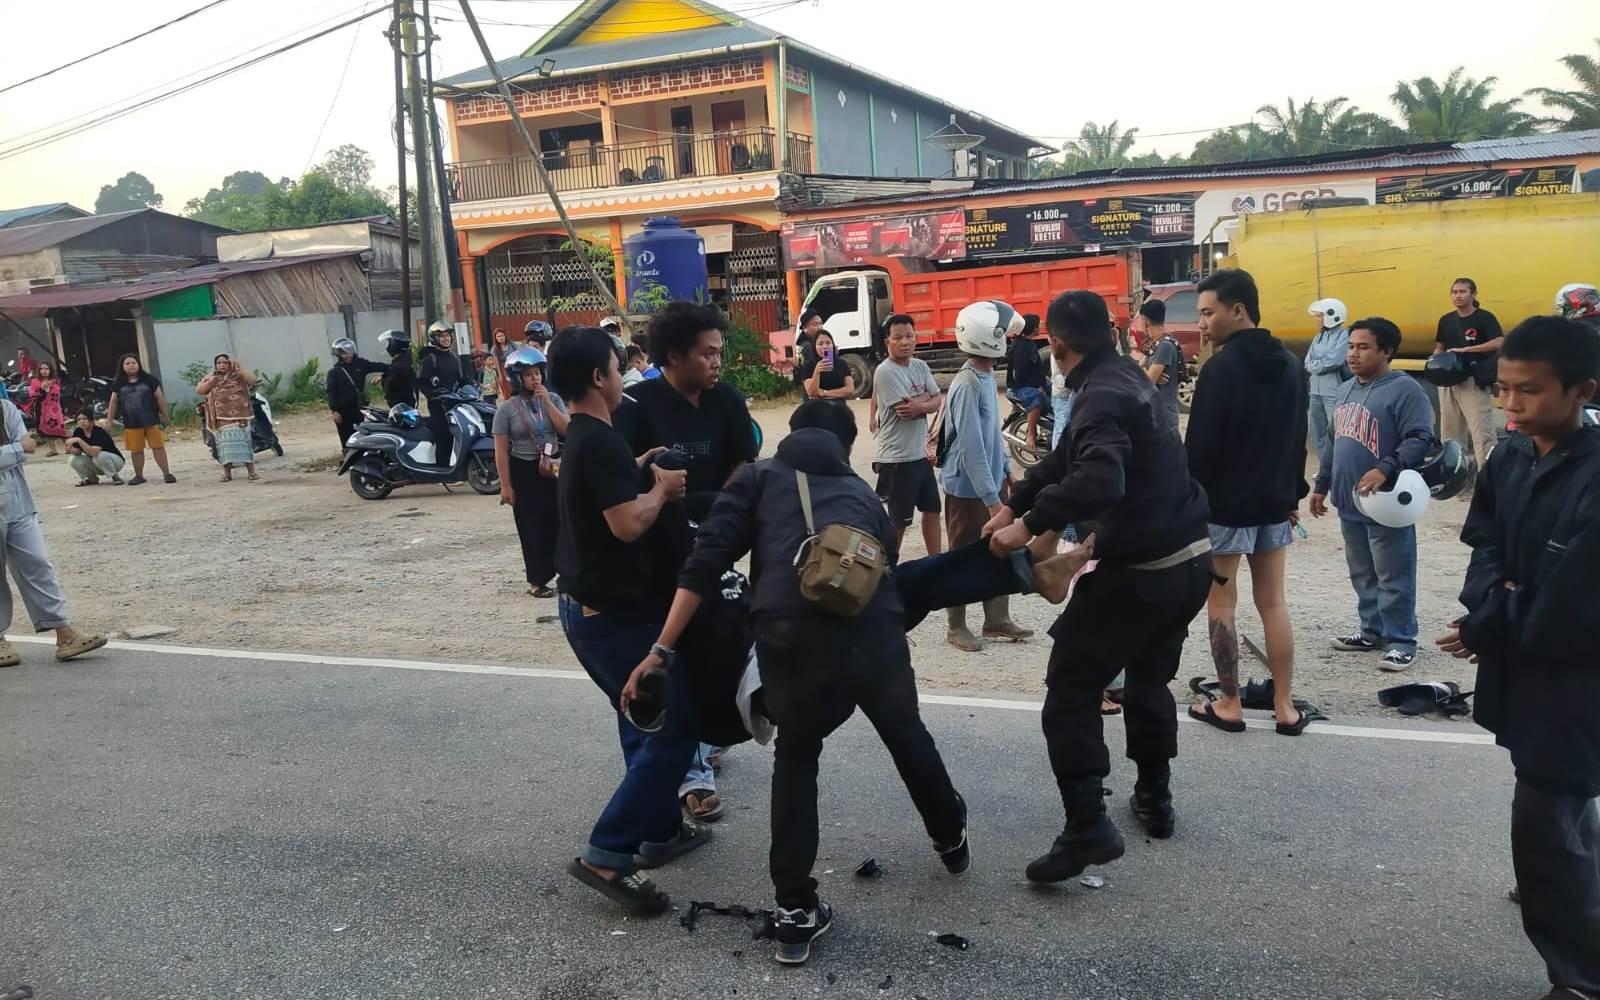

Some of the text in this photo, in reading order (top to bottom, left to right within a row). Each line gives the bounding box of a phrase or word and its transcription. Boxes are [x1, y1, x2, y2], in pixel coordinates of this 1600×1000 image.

[1460, 181, 1491, 192] 16.000
[1154, 203, 1181, 214] 16.000
[1032, 208, 1060, 221] 16.000
[1091, 212, 1141, 224] SIGNATURE
[1033, 222, 1061, 233] REVOLUSI
[1100, 222, 1132, 231] KRETEK
[1155, 224, 1183, 234] KRETEK
[965, 233, 998, 243] KRETEK
[1034, 231, 1061, 242] KRETEK
